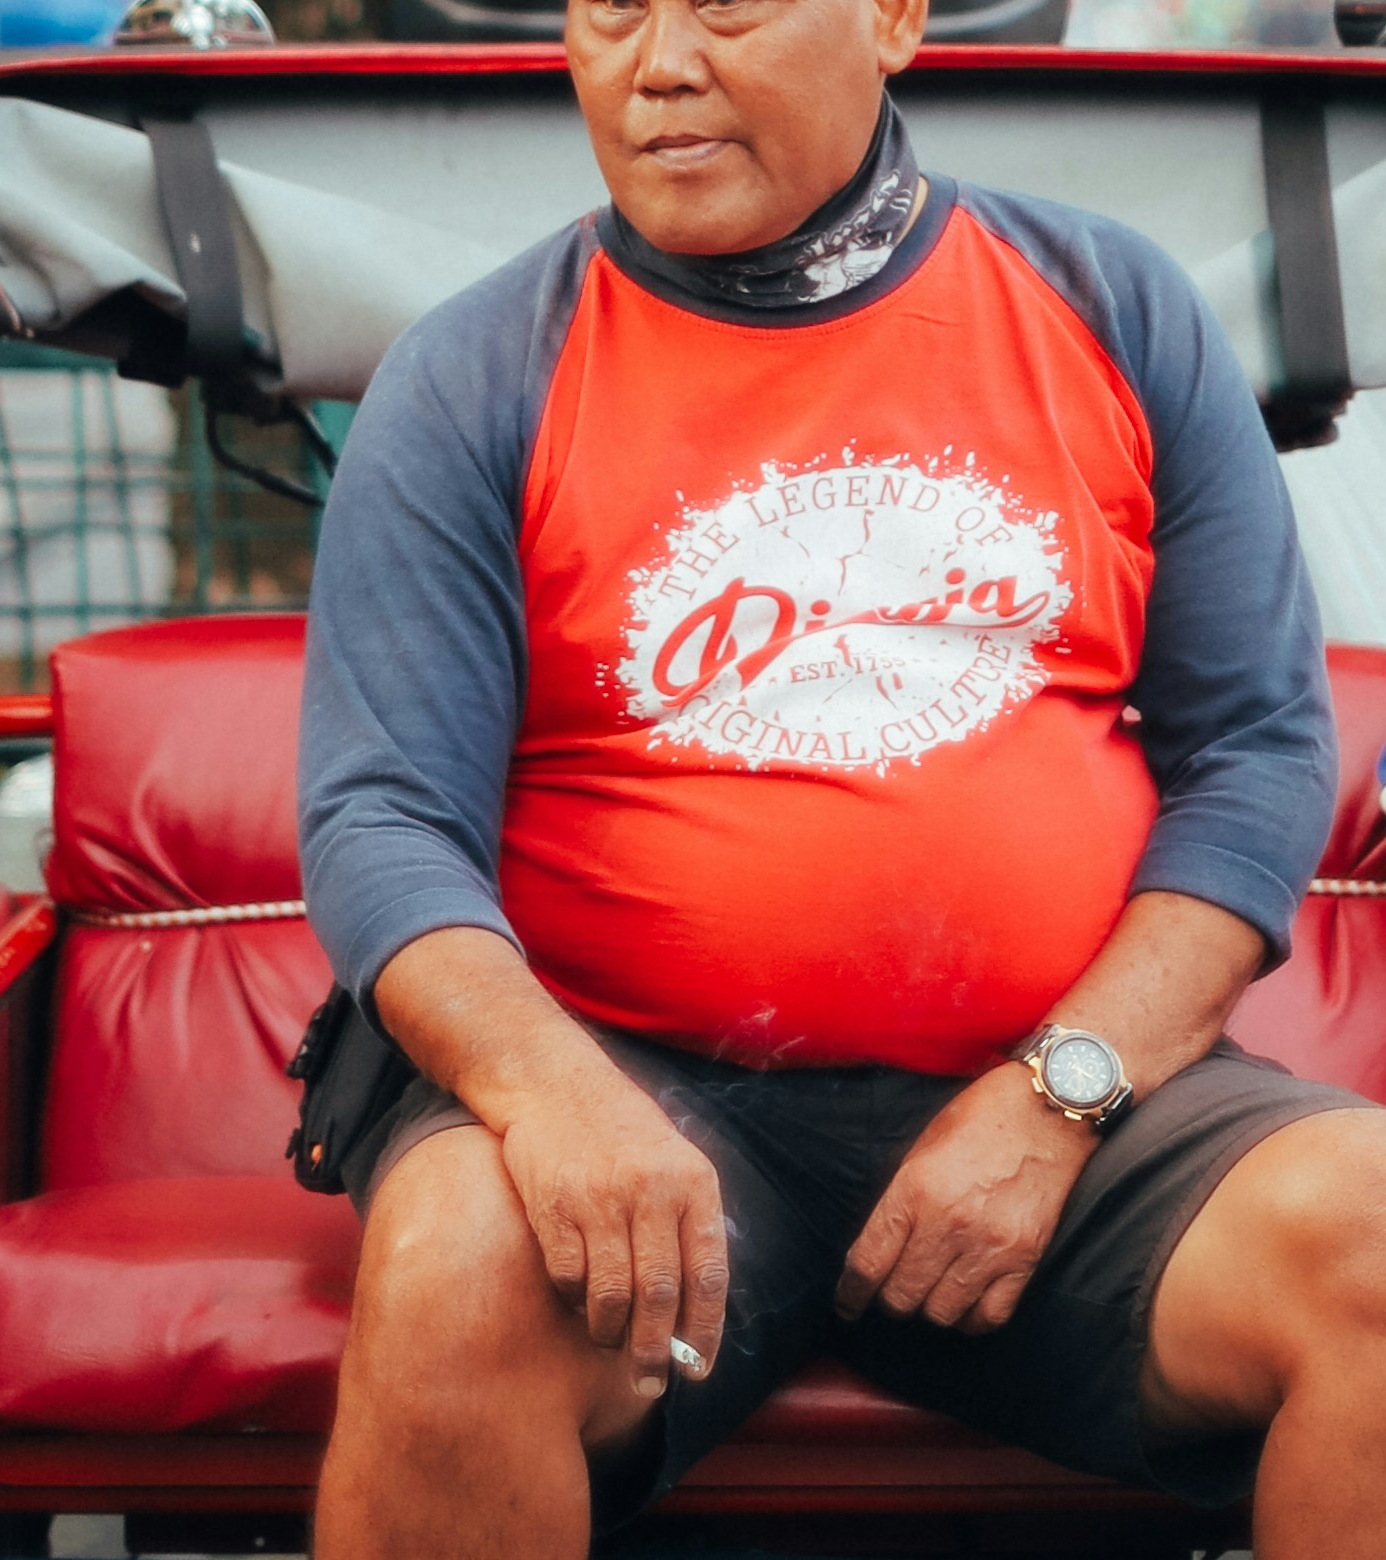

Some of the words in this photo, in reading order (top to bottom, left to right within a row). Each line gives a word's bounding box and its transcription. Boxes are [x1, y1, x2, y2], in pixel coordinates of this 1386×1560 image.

[658, 521, 741, 601] THE
[744, 473, 941, 528] LEGEND
[954, 506, 1014, 547] OF
